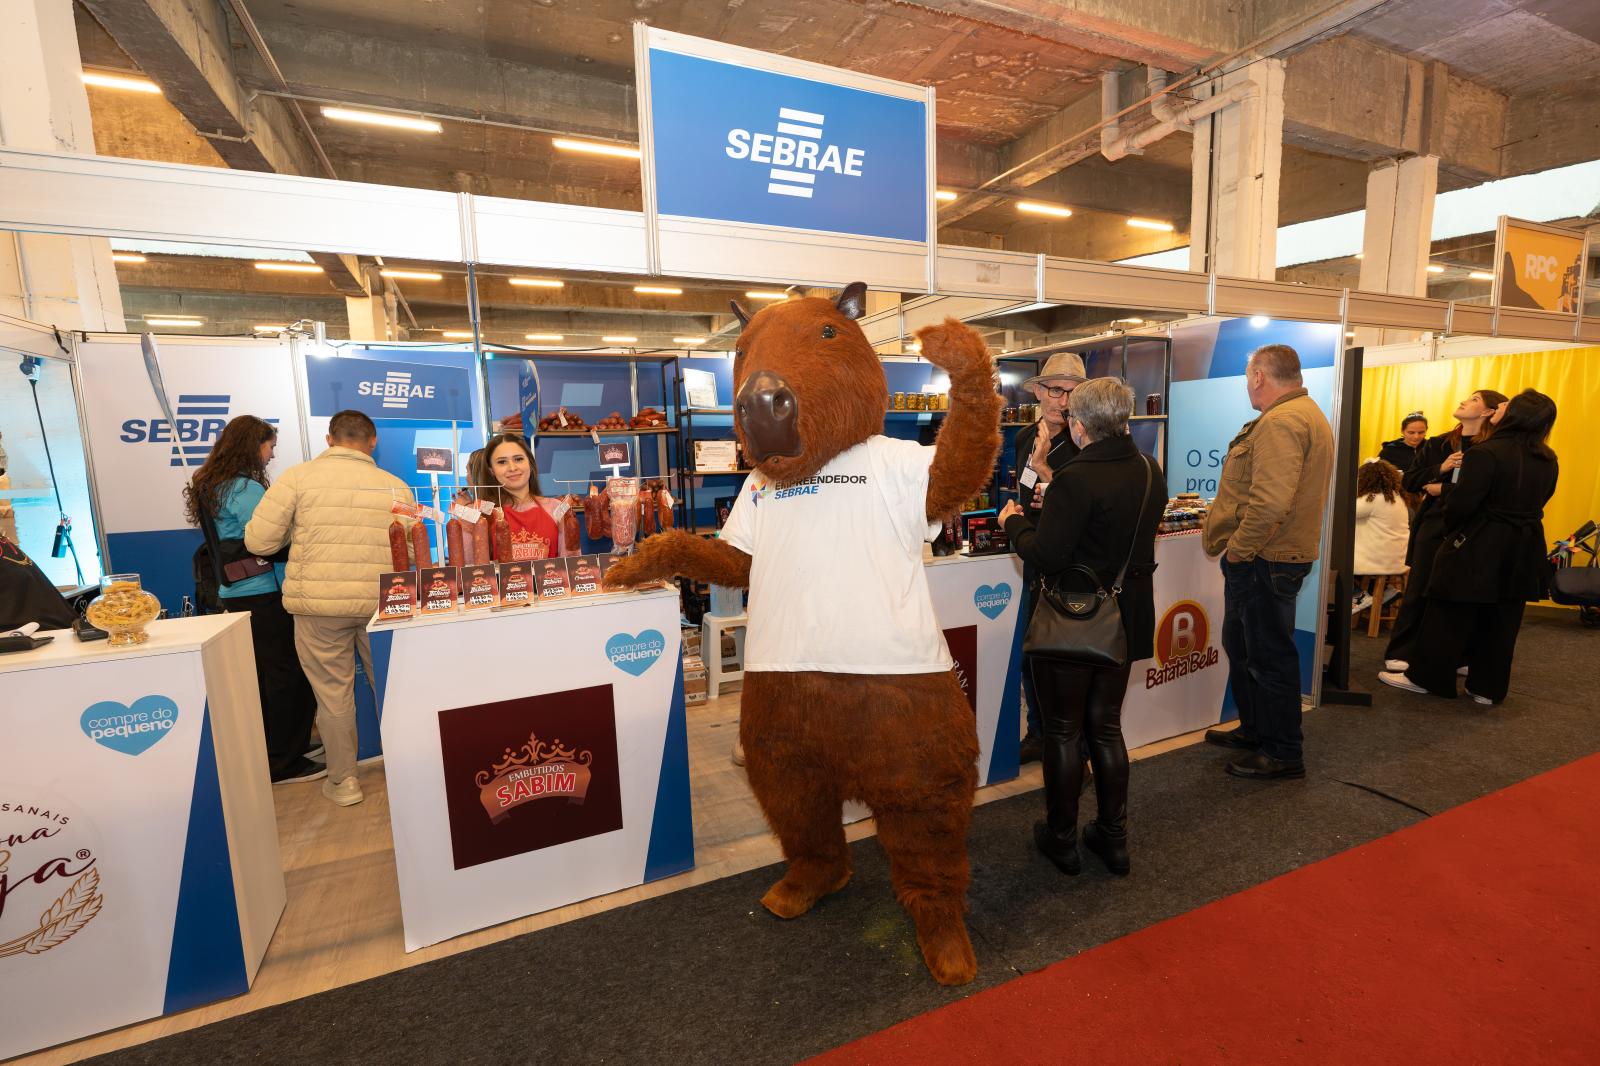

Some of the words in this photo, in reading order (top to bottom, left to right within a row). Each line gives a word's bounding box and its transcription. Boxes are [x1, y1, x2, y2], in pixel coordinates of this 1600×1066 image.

[725, 128, 865, 177] SEBRAE
[1525, 253, 1558, 282] RPC
[357, 381, 435, 398] SEBRAE
[120, 418, 280, 443] SEBR
[1186, 449, 1202, 468] O
[774, 485, 819, 500] SEBRAE
[977, 598, 1009, 608] pequeno
[610, 642, 647, 655] compre
[648, 640, 661, 649] do
[611, 648, 661, 664] pequeno
[1146, 659, 1189, 689] Batata
[1190, 646, 1219, 673] Bella
[88, 712, 149, 729] compre
[152, 707, 173, 720] do
[90, 719, 174, 740] pequeno
[508, 764, 565, 782] EMBUTIDOS
[496, 772, 577, 807] SABIM
